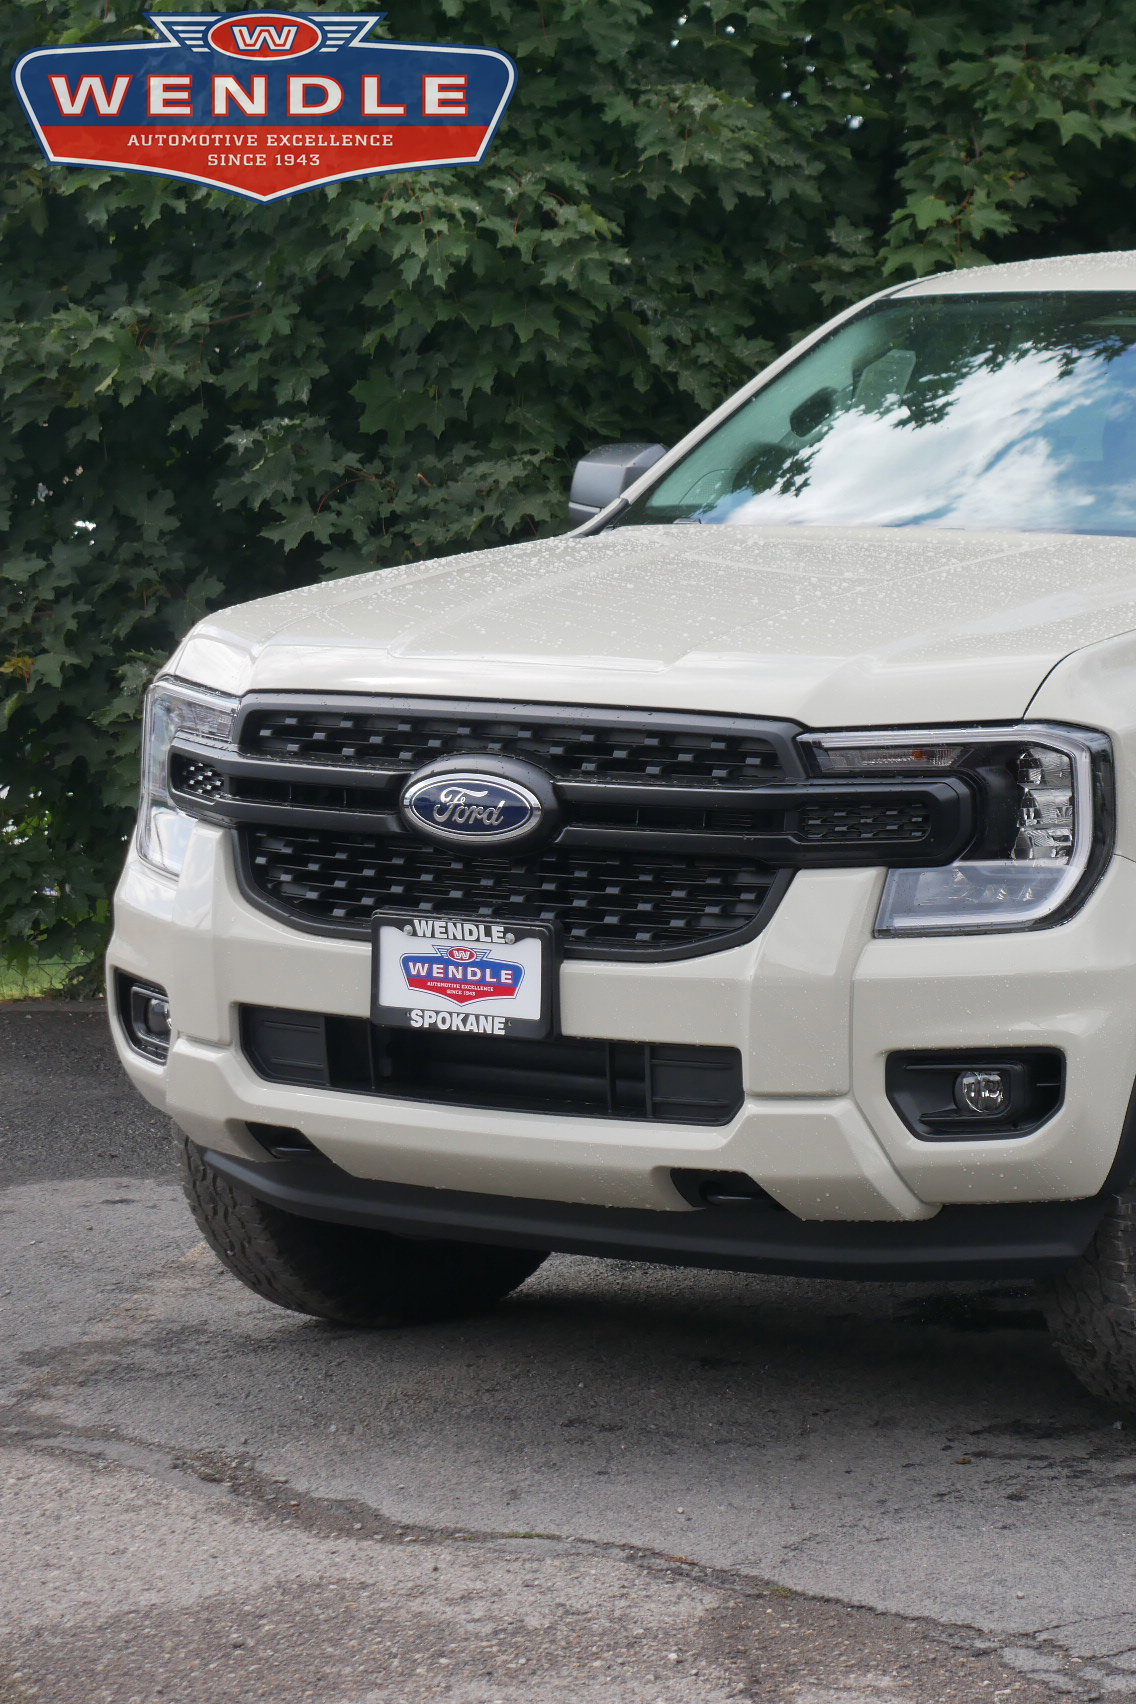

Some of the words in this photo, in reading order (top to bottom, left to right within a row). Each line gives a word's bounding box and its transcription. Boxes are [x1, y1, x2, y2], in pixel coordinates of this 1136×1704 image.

[433, 786, 506, 826] Ford
[413, 919, 506, 944] WENDLE
[408, 961, 514, 984] WENDLE
[410, 1009, 507, 1035] SPOKANE
